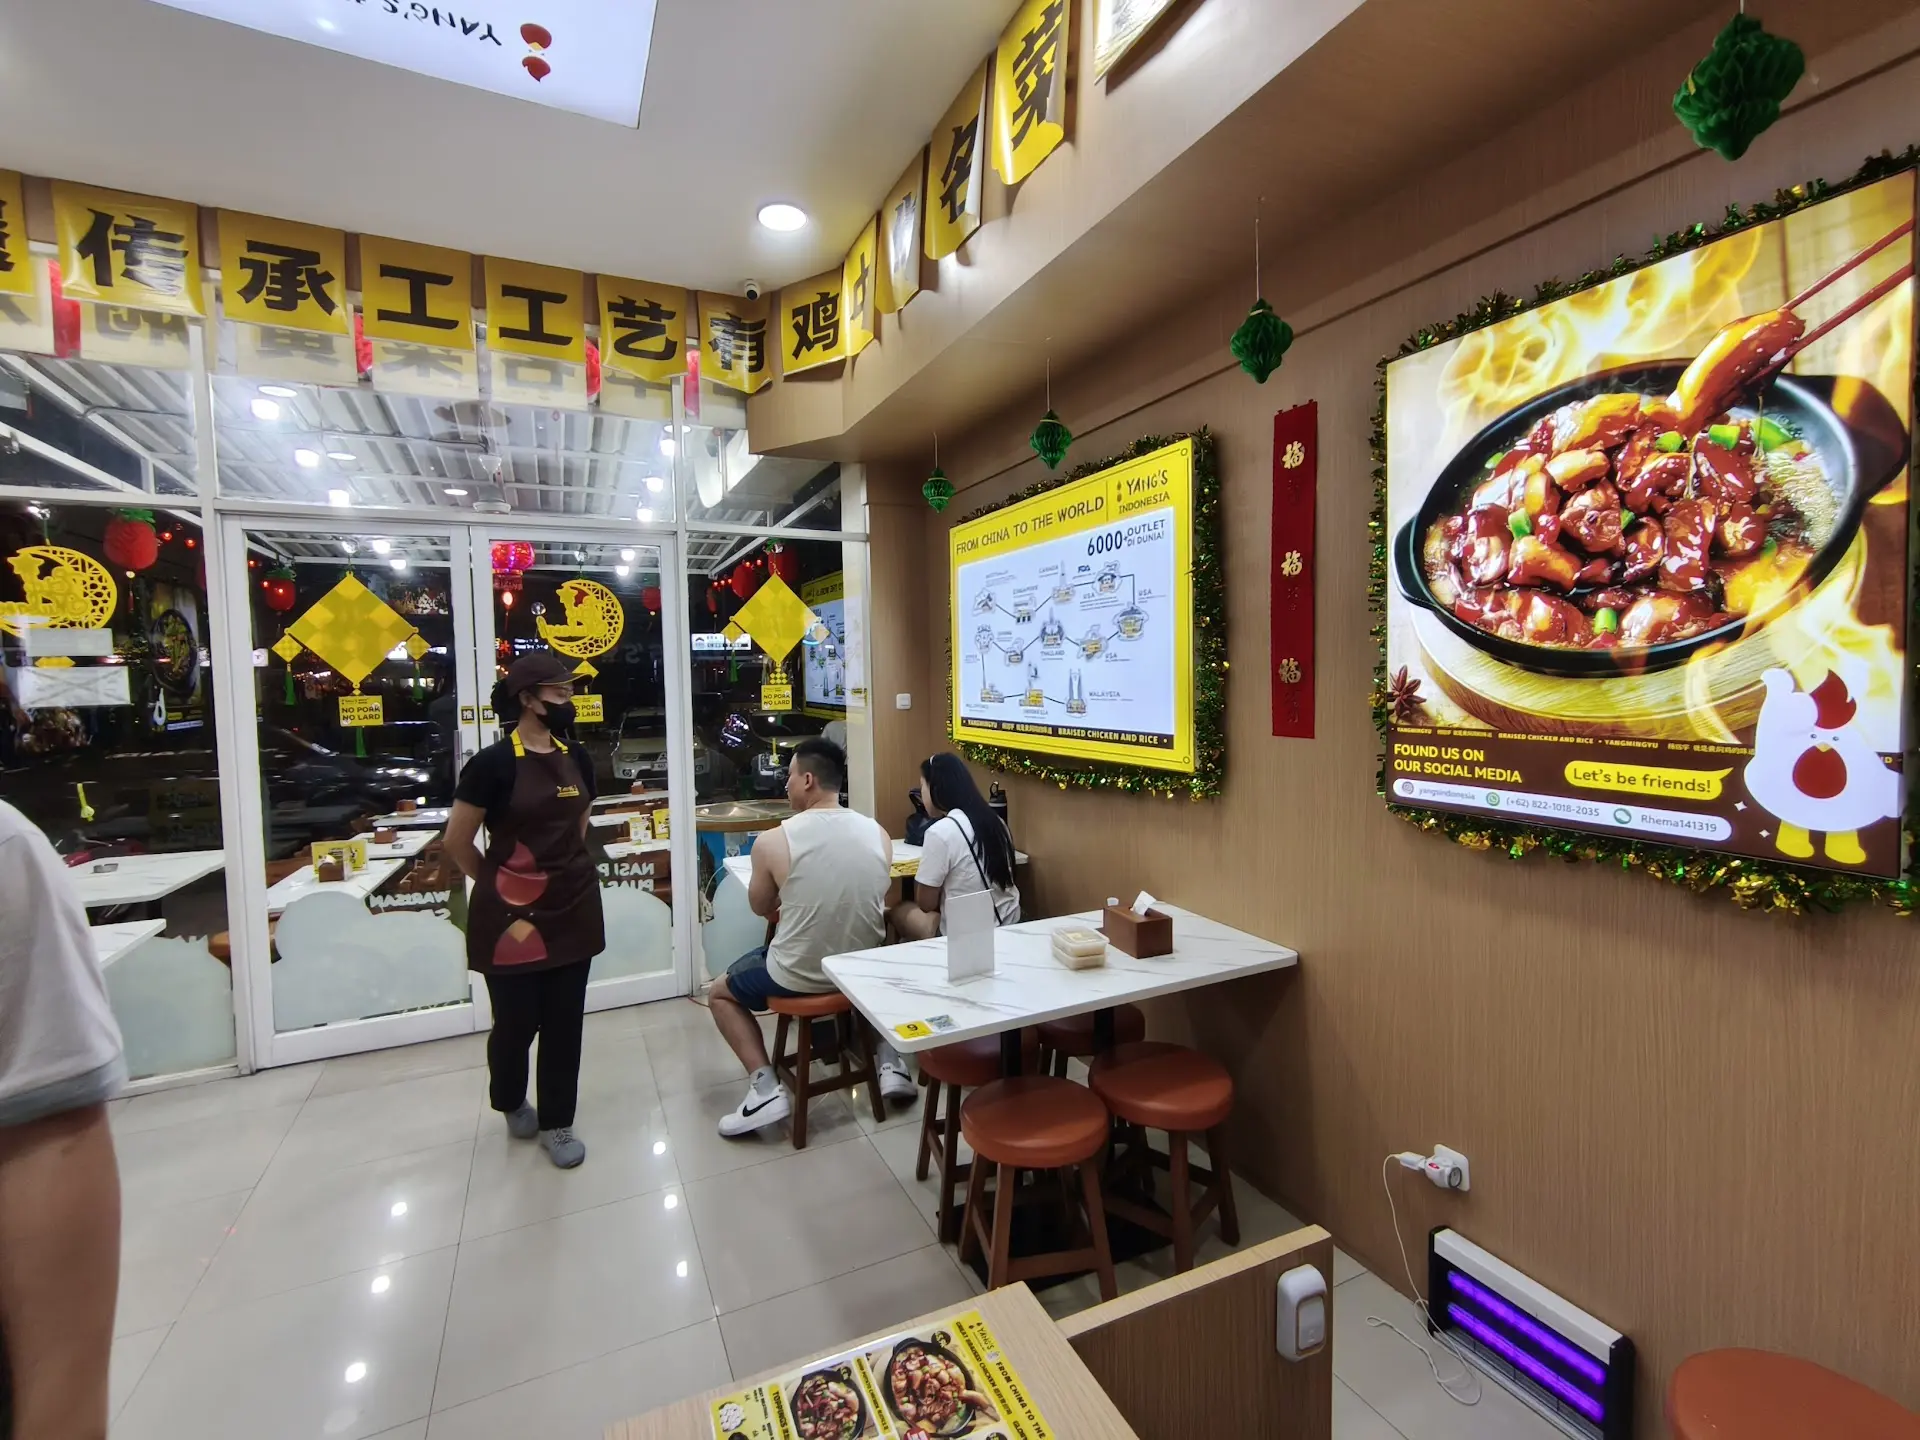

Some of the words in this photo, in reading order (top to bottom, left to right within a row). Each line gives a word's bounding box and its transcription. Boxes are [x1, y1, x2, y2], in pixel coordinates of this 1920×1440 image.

[236, 239, 340, 317] 承
[377, 263, 460, 330] 工
[499, 284, 573, 346] 工
[607, 295, 678, 361] 艺
[791, 291, 840, 361] 鸡
[1282, 440, 1305, 469] 福
[1126, 469, 1168, 495] YANG'S
[1118, 491, 1171, 515] INDONESIA
[956, 538, 979, 555] FROM
[981, 527, 1010, 547] CHINA
[1013, 522, 1028, 537] TO
[1031, 512, 1053, 531] THE
[1057, 496, 1104, 523] WORLD
[1127, 519, 1166, 537] OUTLET
[1127, 538, 1135, 547] DI
[1137, 530, 1165, 545] DUNIA!
[1281, 549, 1303, 577] 福
[1278, 657, 1301, 684] 福
[1058, 727, 1086, 737] BRAISED
[1087, 730, 1119, 740] CHICKEN
[1120, 733, 1137, 742] AND
[1139, 735, 1158, 744] RICE
[1498, 732, 1527, 740] BRAISED
[1527, 734, 1559, 742] CHICKEN
[1605, 739, 1659, 749] YANGMINGYU
[1394, 743, 1438, 758] FOUND
[1441, 747, 1460, 760] US
[1462, 748, 1485, 762] ON
[1394, 759, 1421, 773] OUR
[1424, 761, 1472, 778] SOCIAL
[1475, 766, 1523, 783] MEDIA
[1617, 771, 1636, 785] be
[1642, 774, 1711, 793] friends!
[1506, 796, 1530, 809] (+62)
[1532, 800, 1600, 817] 822-1018-2035
[1641, 814, 1717, 833] Rhema141319
[979, 1361, 997, 1387] CHICKEN
[772, 1391, 788, 1428] TOPPINGS
[995, 1361, 1013, 1383] FROM
[1009, 1384, 1027, 1409] CHINA
[1024, 1409, 1035, 1421] TO
[1032, 1422, 1046, 1440] THE
